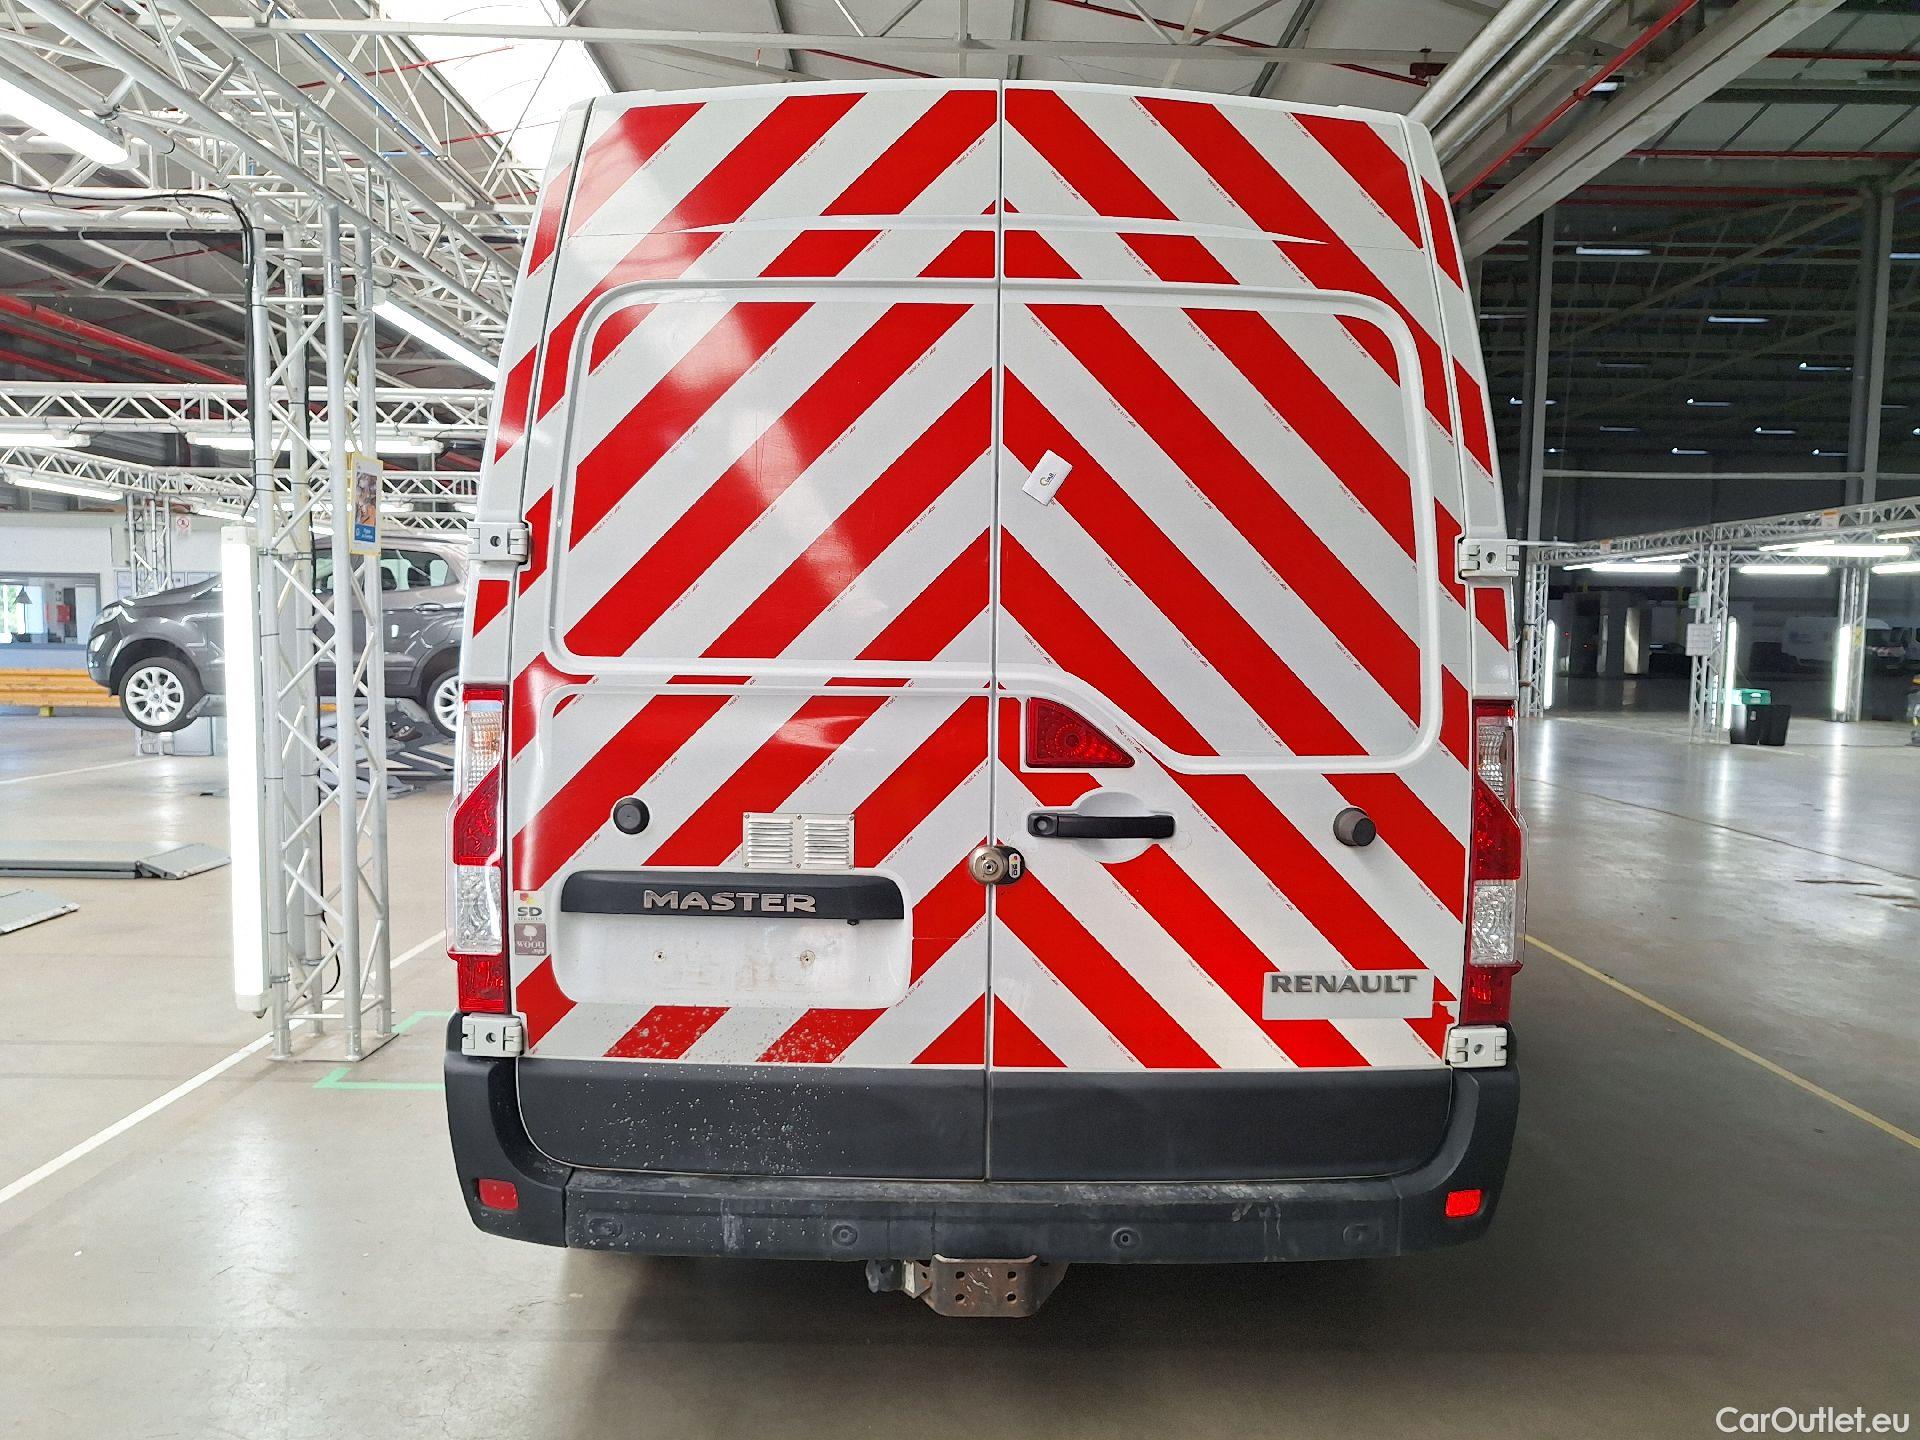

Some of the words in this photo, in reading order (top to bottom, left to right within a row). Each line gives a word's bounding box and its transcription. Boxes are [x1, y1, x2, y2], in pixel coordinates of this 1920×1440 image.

[643, 889, 816, 913] MASTER
[517, 906, 543, 917] SD
[1270, 974, 1418, 994] RENAULT
